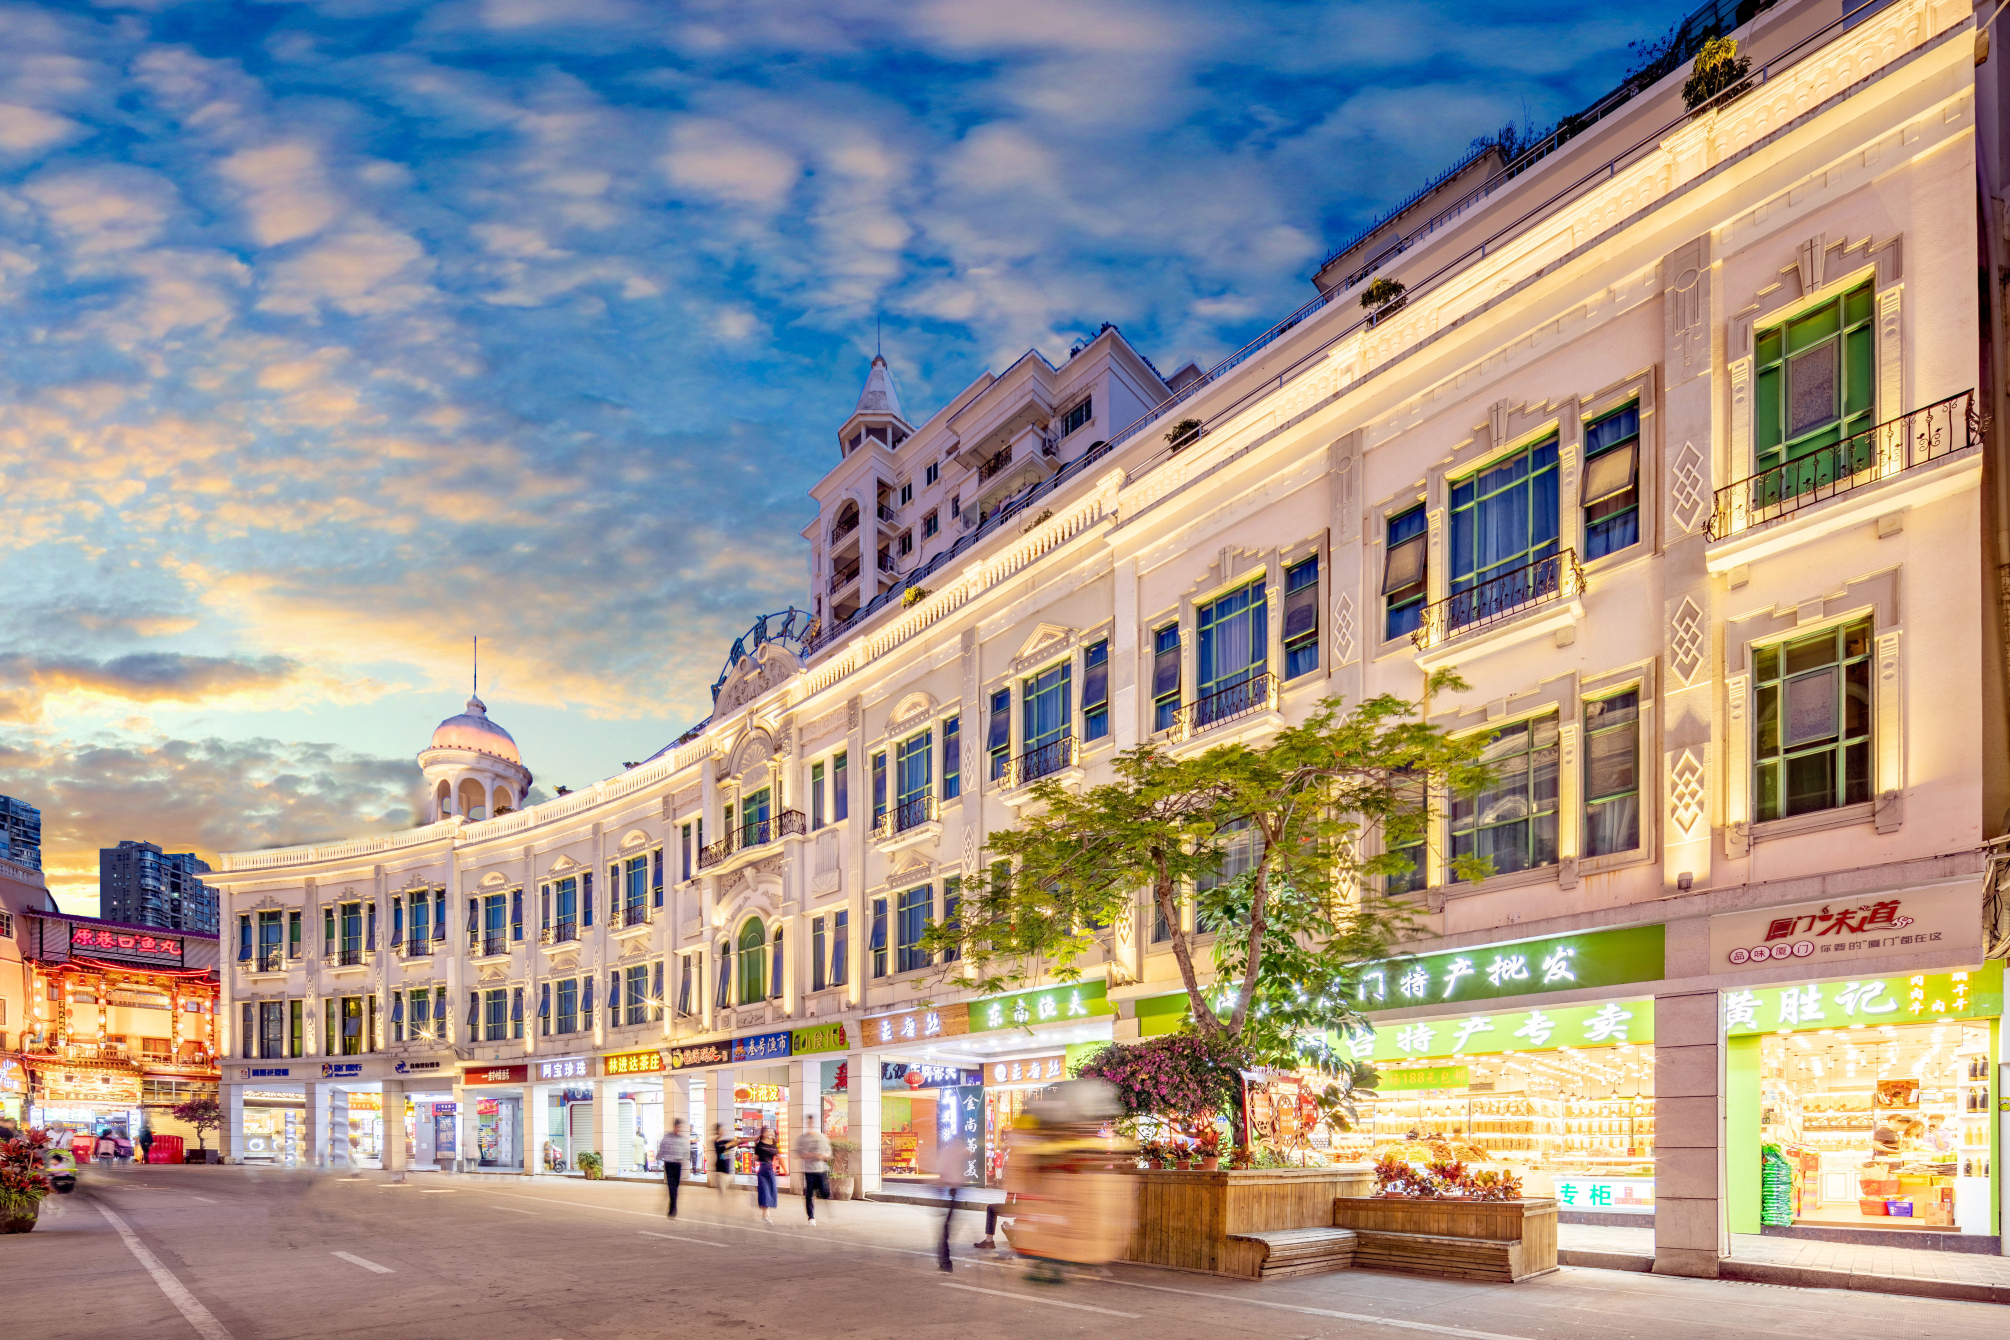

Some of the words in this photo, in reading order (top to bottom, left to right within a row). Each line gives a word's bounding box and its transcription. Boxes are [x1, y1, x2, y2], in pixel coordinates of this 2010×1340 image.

[1764, 900, 1901, 942] 厦门味道
[71, 928, 182, 955] 原巷口鱼丸
[1731, 943, 1811, 962] 品味厦门
[1317, 946, 1577, 1009] 门特产批发
[988, 990, 1087, 1027] 东南渔夫
[1725, 981, 1898, 1030] 黄胜记
[542, 1061, 586, 1078] 阿宝珍珠
[608, 1054, 660, 1074] 林进达茶庄
[734, 1084, 779, 1102] 叶批发
[1560, 1183, 1612, 1206] 专柜
